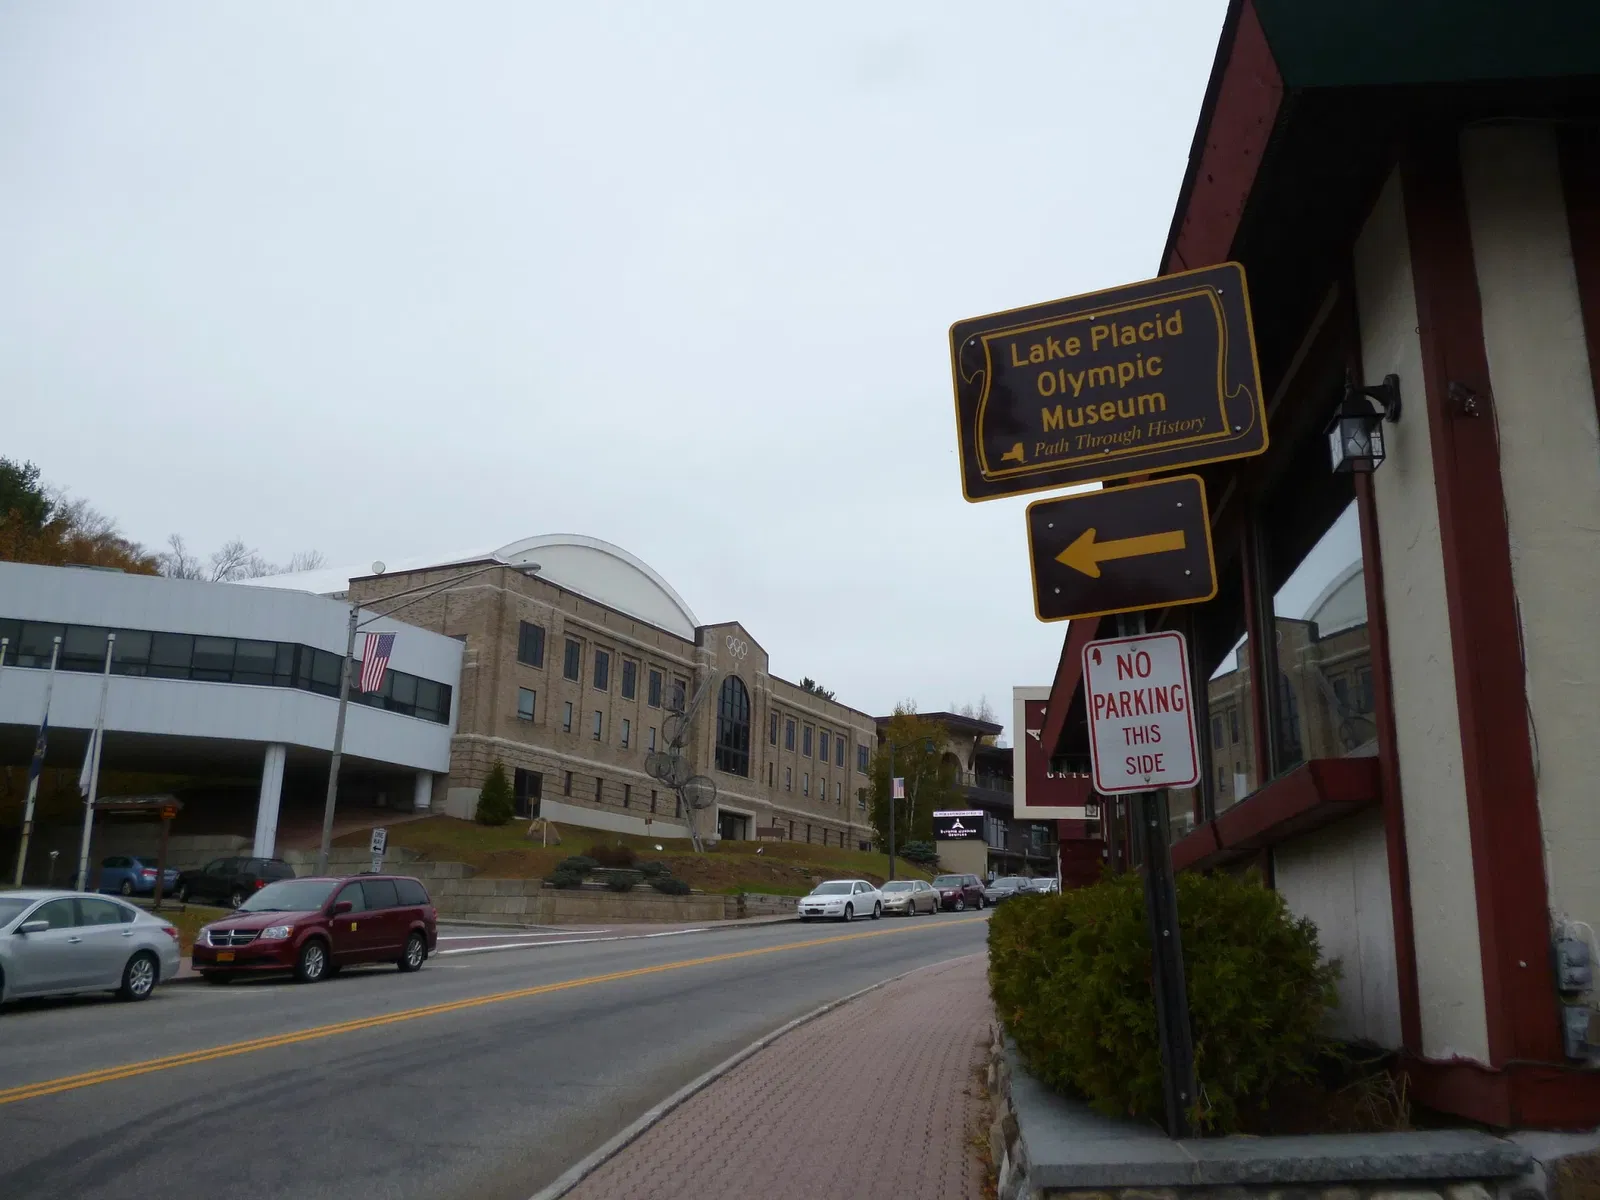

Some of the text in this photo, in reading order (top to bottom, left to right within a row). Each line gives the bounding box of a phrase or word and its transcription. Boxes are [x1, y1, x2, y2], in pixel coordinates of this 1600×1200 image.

[1011, 309, 1183, 367] Lake Placid
[1037, 353, 1163, 397] Olympic
[1041, 392, 1167, 432] Museum
[1034, 416, 1206, 457] Path Through History
[1116, 651, 1152, 680] NO
[1093, 684, 1185, 721] PARKING
[1122, 725, 1162, 746] THIS
[1125, 753, 1166, 775] SIDE
